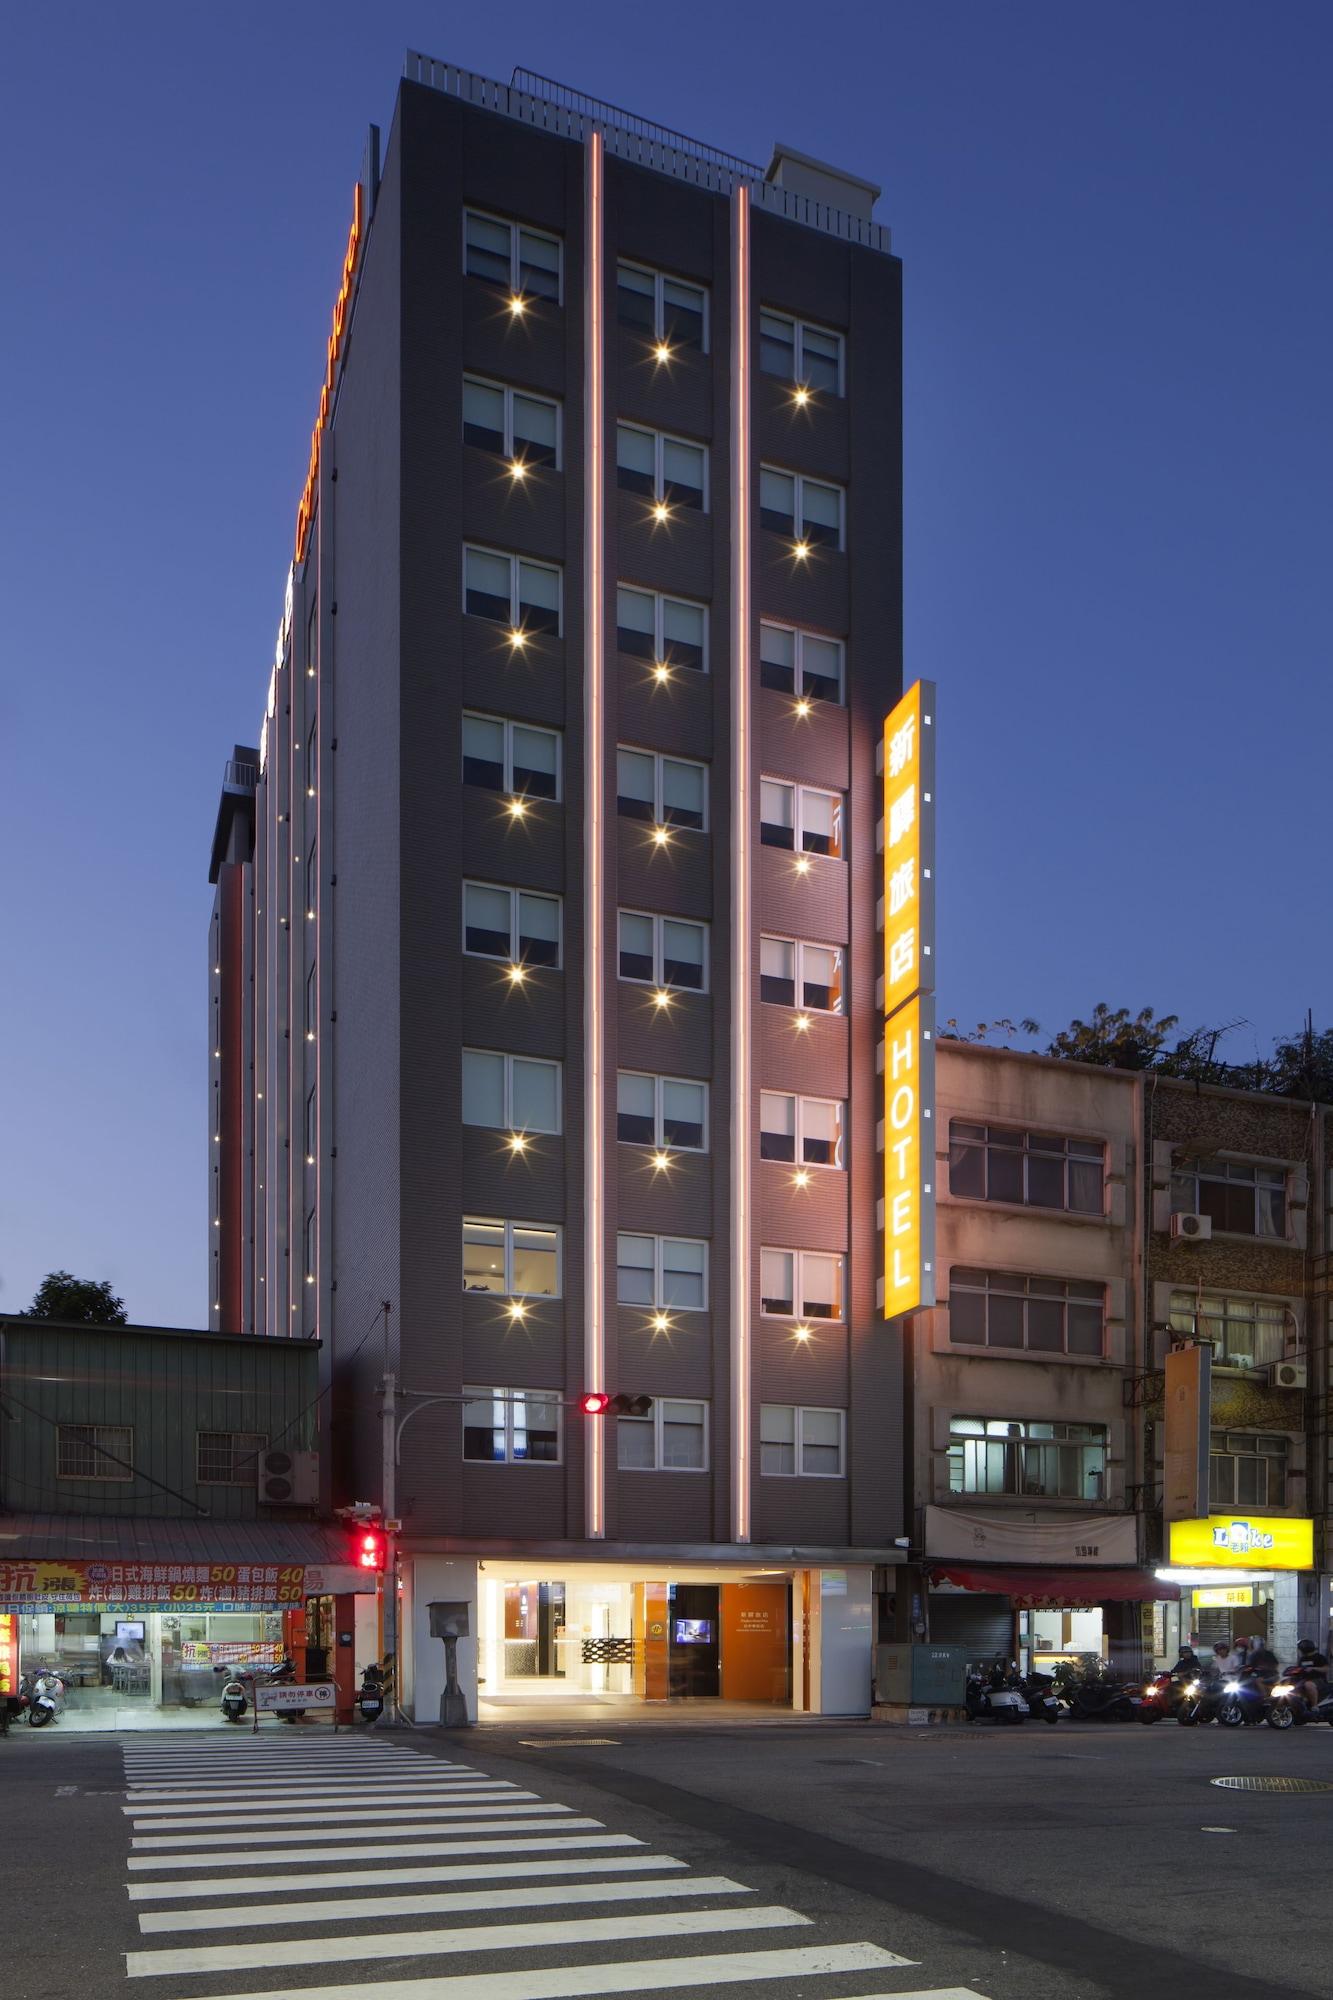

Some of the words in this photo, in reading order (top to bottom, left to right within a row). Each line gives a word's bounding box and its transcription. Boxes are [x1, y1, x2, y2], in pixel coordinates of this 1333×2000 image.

[890, 1029, 914, 1289] HOTEL
[211, 1566, 235, 1582] 50
[237, 1566, 278, 1583] 蛋包飯
[279, 1567, 304, 1583] 40
[172, 1584, 197, 1600] 50
[278, 1585, 301, 1601] 50
